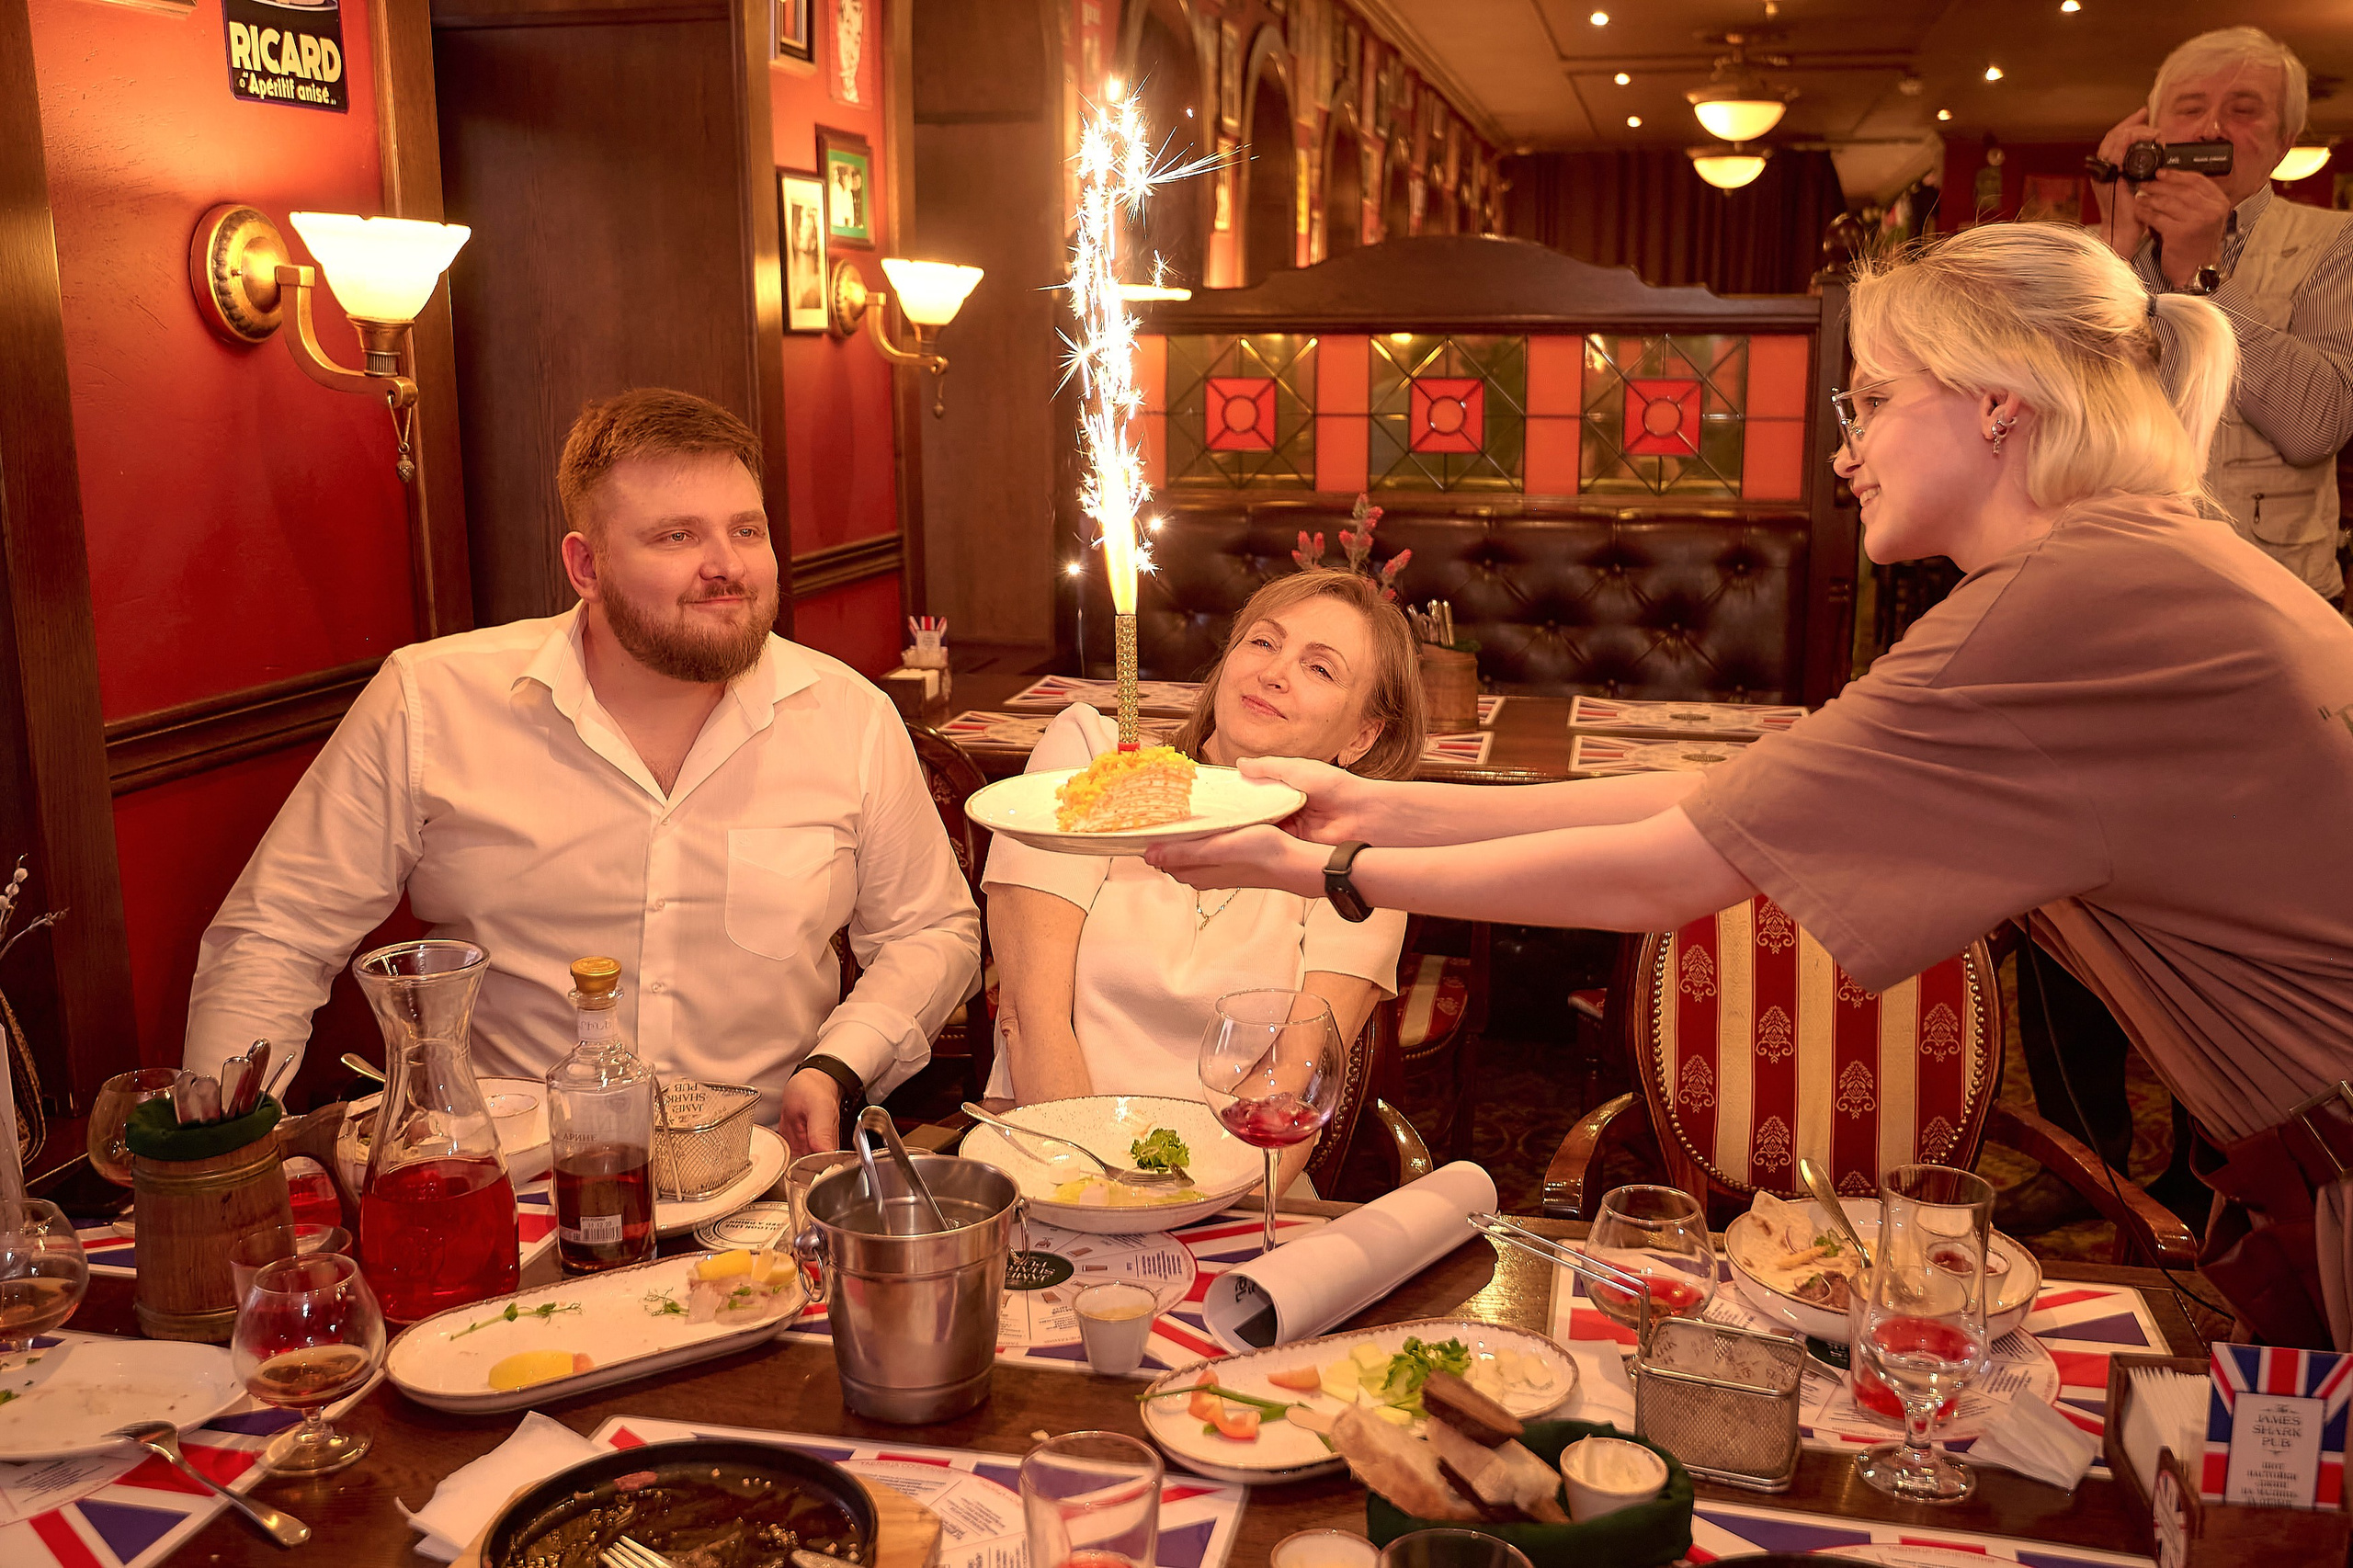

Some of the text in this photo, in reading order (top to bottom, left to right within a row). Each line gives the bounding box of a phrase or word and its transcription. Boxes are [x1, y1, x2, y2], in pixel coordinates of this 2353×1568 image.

[229, 21, 342, 83] RICARD
[674, 1083, 698, 1092] PUB
[2256, 1414, 2301, 1426] JAMES
[2252, 1424, 2302, 1437] SHARK
[2261, 1437, 2290, 1447] PUB
